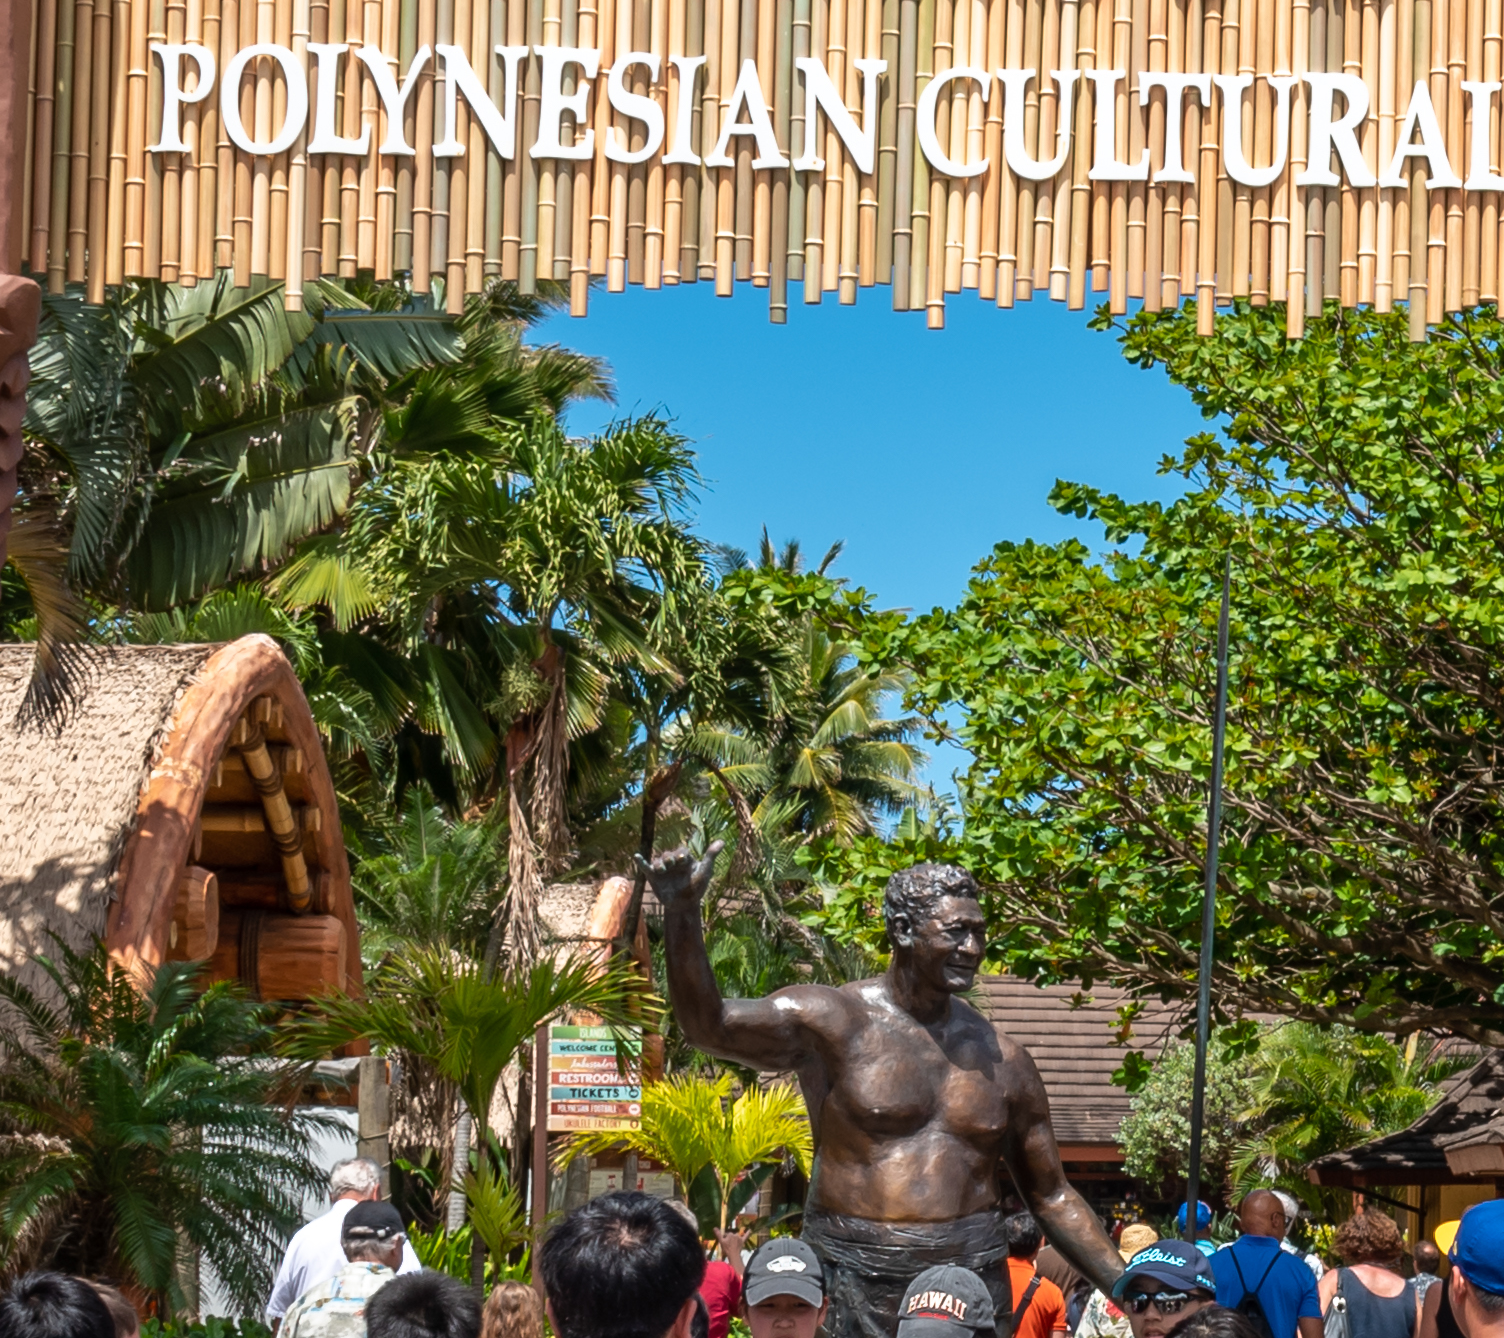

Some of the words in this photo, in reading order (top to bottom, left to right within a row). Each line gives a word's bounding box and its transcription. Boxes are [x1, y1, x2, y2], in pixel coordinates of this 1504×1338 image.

[146, 43, 888, 174] POLYNESIAN
[560, 1044, 597, 1052] WELCOME
[600, 1044, 617, 1052] CEN
[559, 1073, 624, 1084] RESTROOM
[570, 1088, 620, 1098] TICKETS
[907, 1291, 968, 1321] HAWAII
